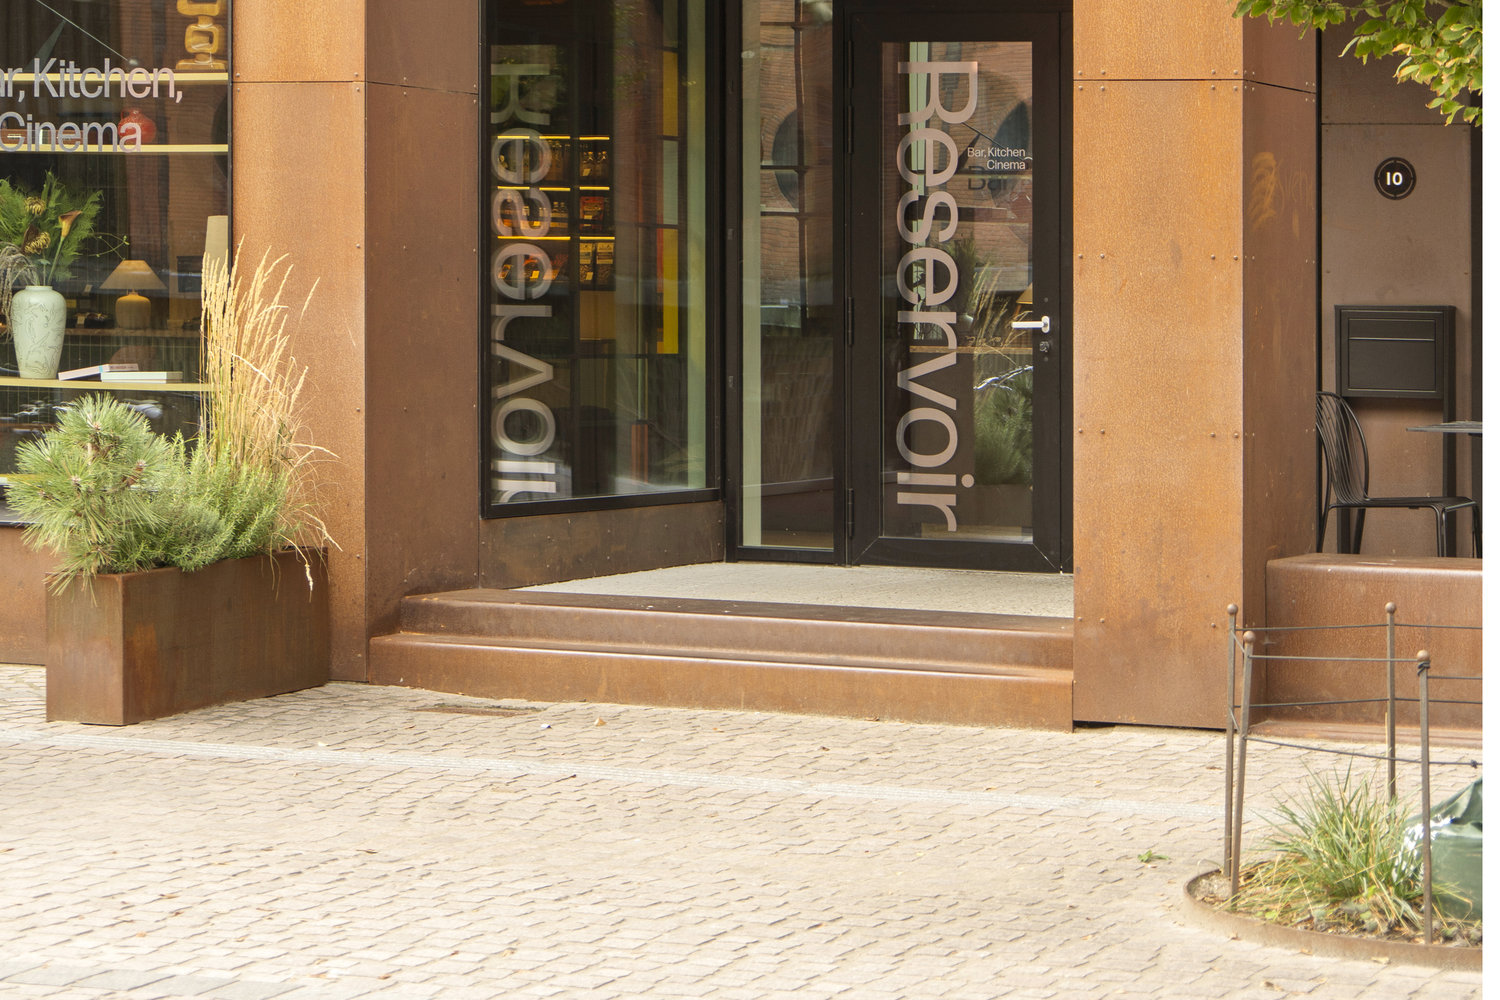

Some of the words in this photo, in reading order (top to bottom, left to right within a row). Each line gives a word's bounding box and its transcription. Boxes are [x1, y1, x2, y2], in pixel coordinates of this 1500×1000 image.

[34, 58, 183, 104] Kitchen,
[0, 112, 142, 152] Cinema
[967, 147, 987, 158] Bar,
[988, 147, 1026, 157] Kitchen
[986, 160, 1026, 170] Cinema
[1386, 172, 1403, 186] 10
[896, 62, 978, 532] Reservoir
